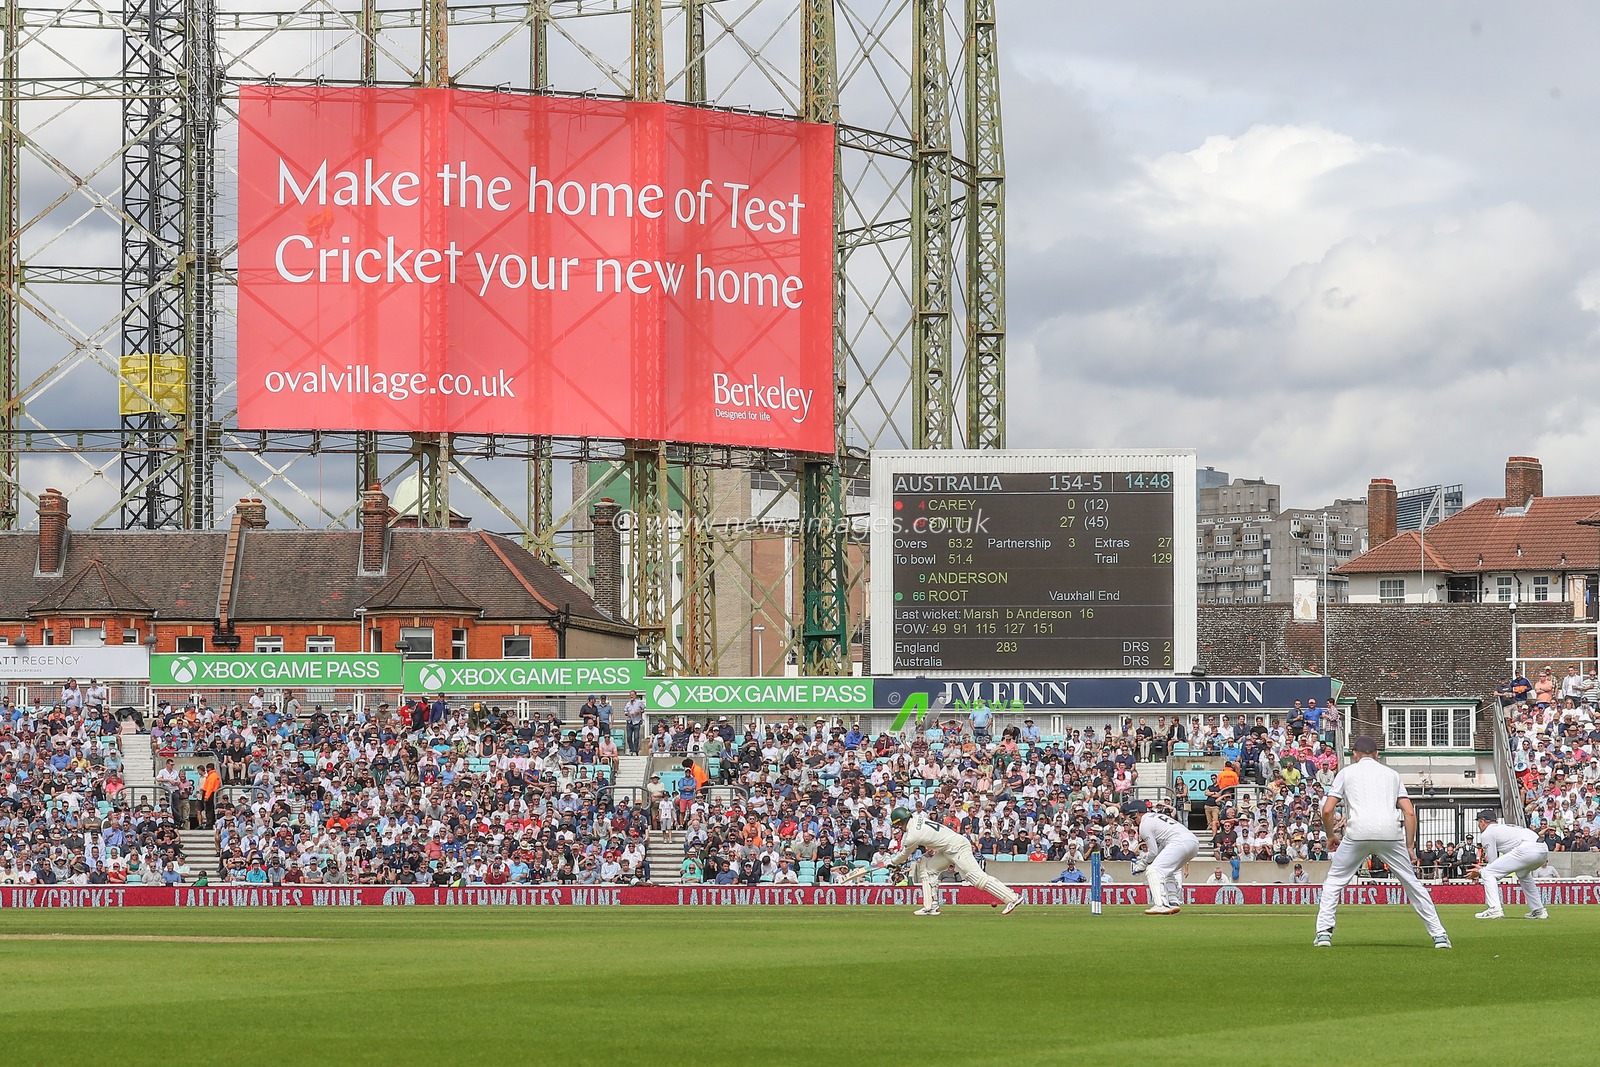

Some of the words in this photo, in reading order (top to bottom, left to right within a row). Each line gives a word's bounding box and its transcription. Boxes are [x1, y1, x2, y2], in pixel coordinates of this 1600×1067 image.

[278, 157, 420, 206] Make
[437, 161, 512, 211] the
[528, 165, 664, 219] home
[674, 179, 713, 225] of
[723, 182, 806, 235] Test
[275, 234, 464, 284] Cricket
[475, 252, 579, 297] your
[596, 258, 685, 296] new
[696, 253, 804, 309] home
[265, 364, 516, 400] ovalvillage.co.uk
[713, 373, 813, 424] Berkeley
[715, 408, 746, 420] Designed
[748, 411, 758, 420] for
[759, 411, 771, 422] life
[894, 475, 1003, 491] AUSTRALIA
[1049, 475, 1103, 491] 154-5
[1125, 473, 1171, 489] 14:48
[918, 501, 926, 511] 4
[928, 500, 977, 511] CAREY
[1067, 499, 1076, 510] 0
[1084, 499, 1109, 512] (12)
[928, 516, 972, 529] SMITH
[1060, 516, 1076, 528] 27
[1084, 516, 1109, 530] (45)
[894, 538, 928, 549] Overs
[948, 538, 973, 549] 63.2
[987, 538, 1052, 550] Partnership
[1068, 537, 1076, 548] 3
[1095, 537, 1130, 548] Extras
[1158, 537, 1172, 548] 27
[894, 554, 907, 565] To
[910, 554, 936, 565] bowl
[948, 554, 973, 565] 51.4
[1094, 553, 1118, 564] Trail
[1152, 553, 1172, 564] 129
[919, 574, 926, 583] 9
[928, 572, 1008, 584] ANDERSON
[912, 591, 926, 601] 66
[928, 590, 969, 602] ROOT
[1049, 590, 1095, 601] Vauxhall
[1098, 590, 1120, 601] End
[894, 609, 919, 620] Last
[922, 609, 961, 620] wicket:
[963, 608, 999, 619] Marsh
[1006, 608, 1014, 619] b
[1016, 608, 1072, 619] Anderson
[1080, 608, 1094, 619] 16
[894, 623, 929, 634] FOW:
[931, 623, 947, 634] 49
[953, 623, 967, 634] 91
[976, 623, 996, 634] 115
[1004, 623, 1025, 634] 127
[1033, 623, 1054, 634] 151
[894, 641, 940, 655] England
[996, 641, 1018, 653] 283
[1123, 641, 1150, 652] DRS
[1163, 641, 1171, 652] 2
[0, 656, 19, 665] TT
[22, 656, 80, 665] REGENCY
[894, 656, 943, 667] Australia
[1123, 655, 1150, 666] DRS
[1163, 655, 1171, 666] 2
[201, 661, 258, 678] XBOX
[260, 661, 322, 678] GAME
[327, 661, 380, 678] PASS
[450, 667, 507, 685] XBOX
[510, 667, 573, 685] GAME
[577, 667, 631, 685] PASS
[684, 685, 742, 703] XBOX
[745, 685, 808, 703] GAME
[813, 685, 867, 703] PASS
[938, 681, 981, 705] JM
[991, 681, 1070, 705] FINN
[1134, 680, 1179, 704] JM
[1186, 680, 1266, 704] FINN
[1189, 778, 1207, 791] 20
[924, 820, 940, 832] 4
